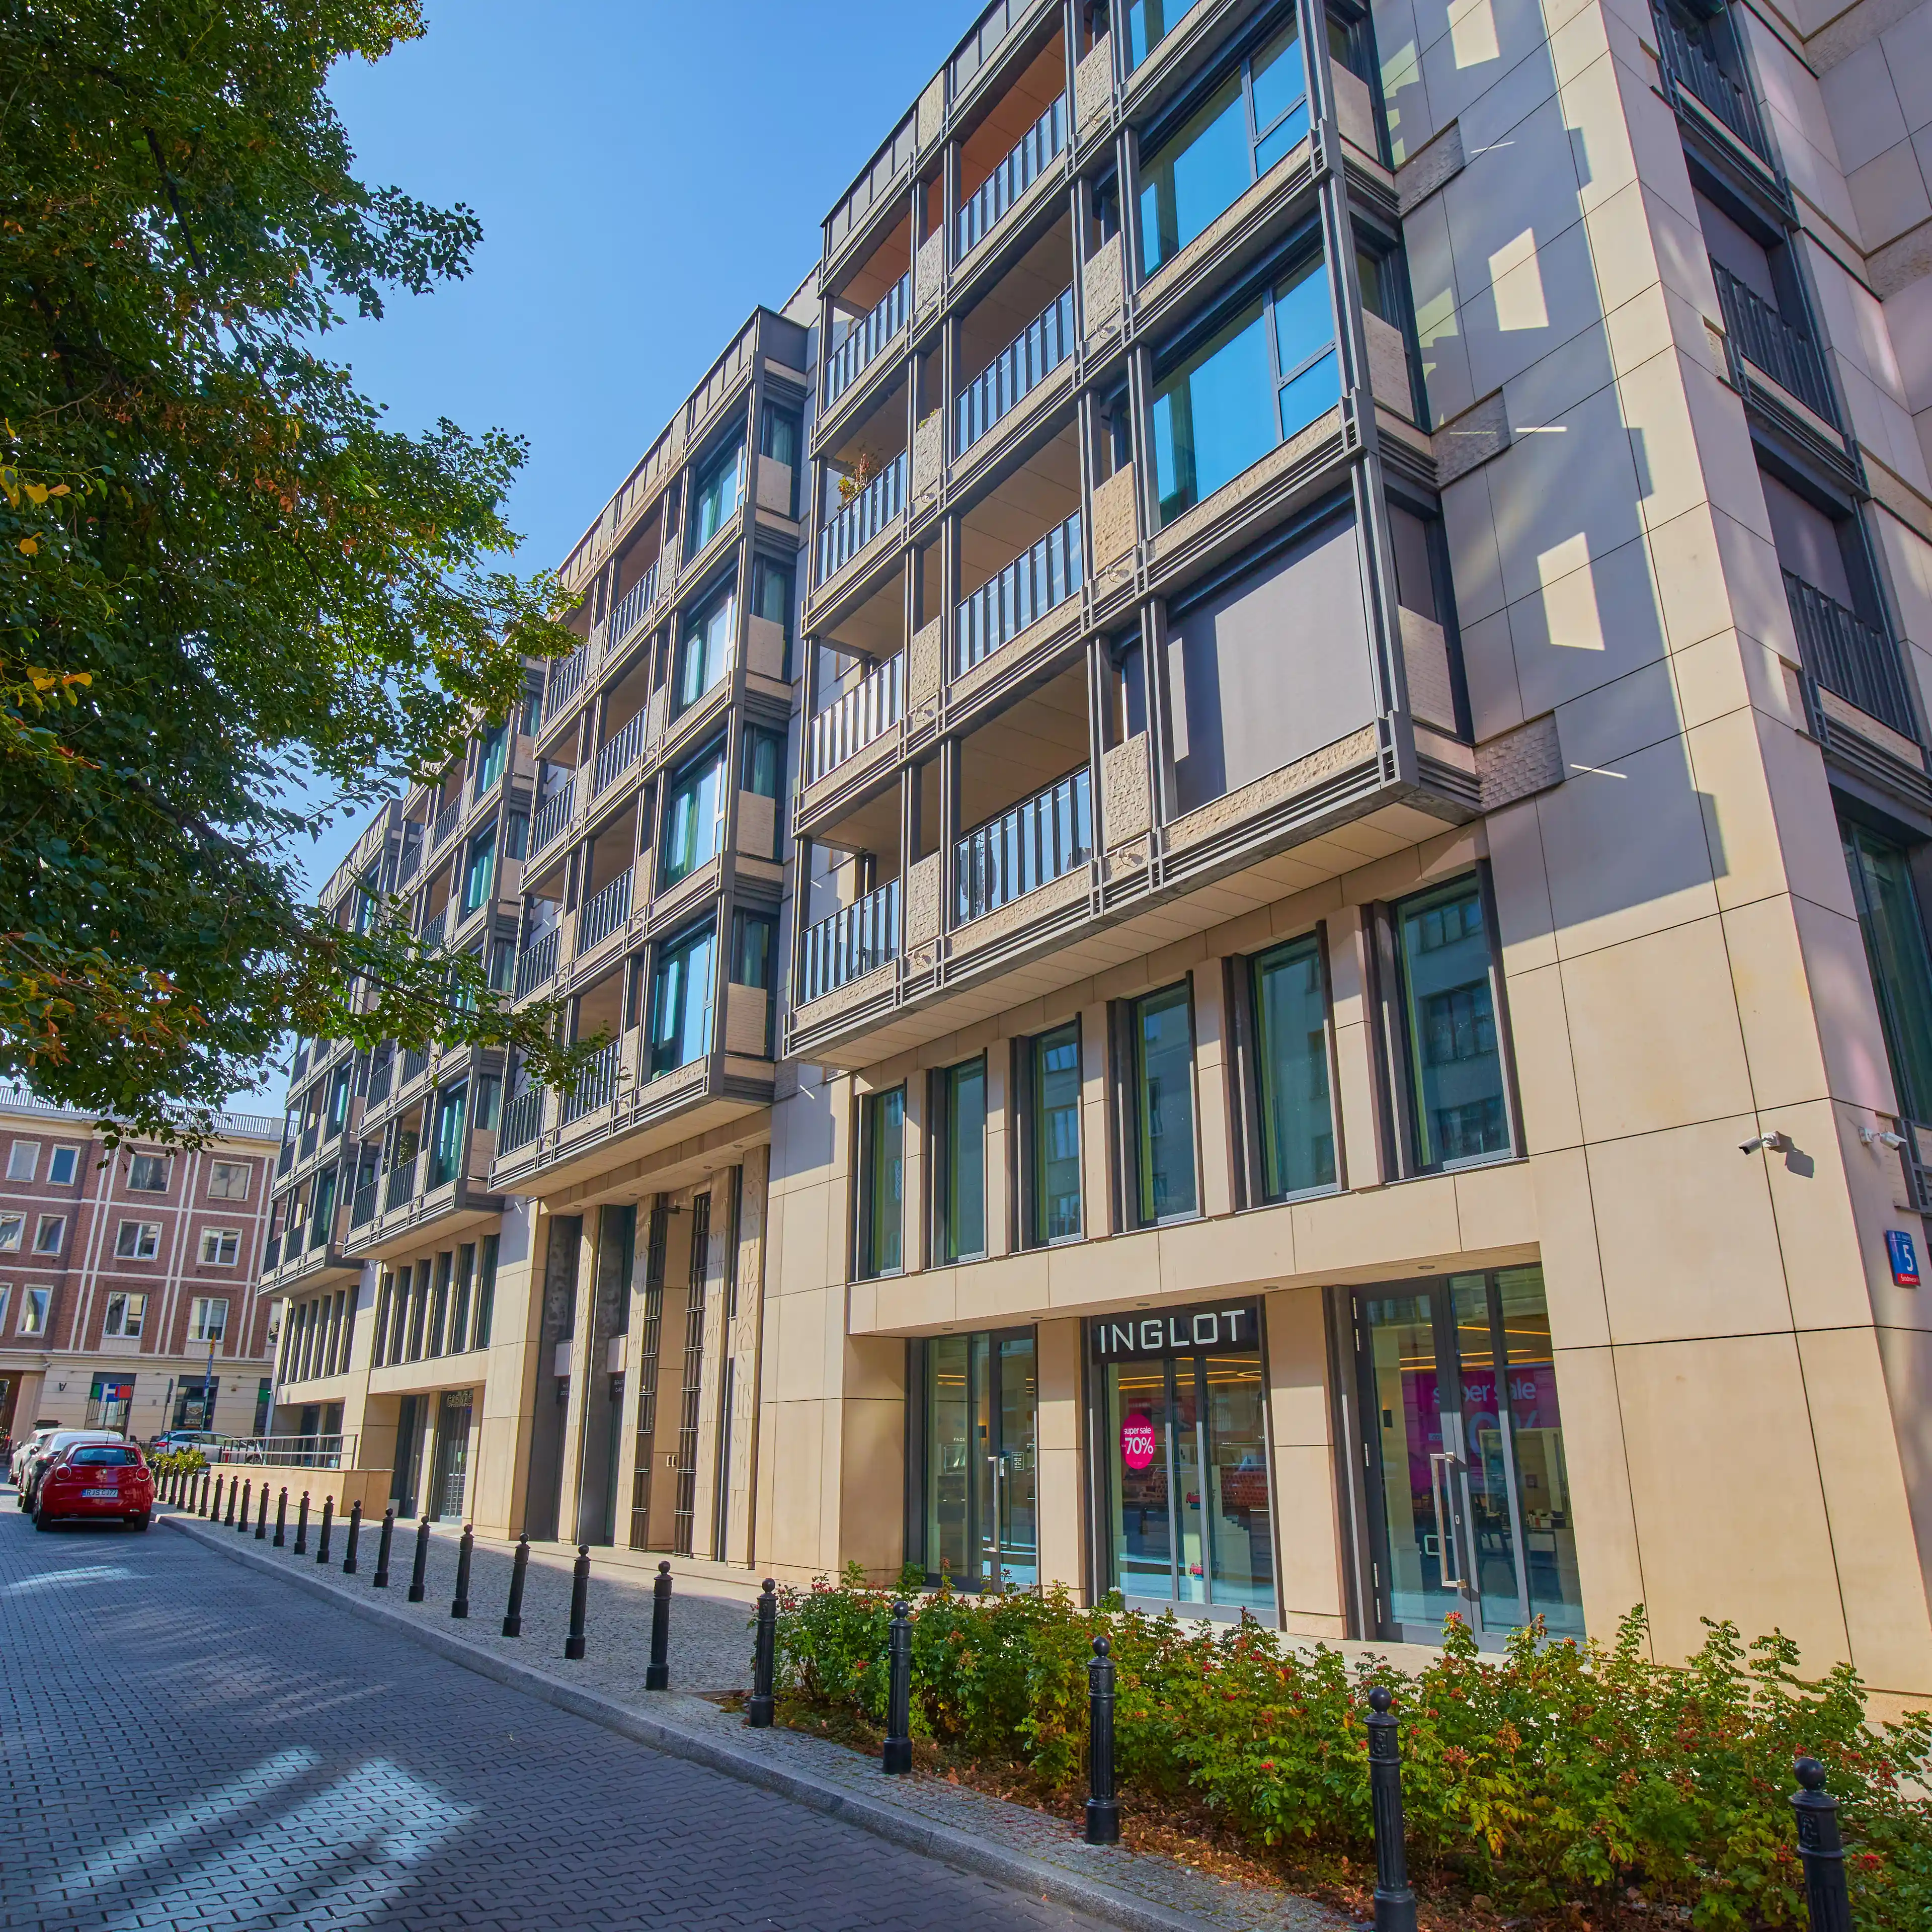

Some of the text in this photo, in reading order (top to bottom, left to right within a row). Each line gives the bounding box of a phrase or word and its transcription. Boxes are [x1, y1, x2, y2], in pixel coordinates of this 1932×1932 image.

[1903, 1244, 1913, 1271] 5
[1100, 1310, 1245, 1353] INGLOT
[1123, 1426, 1151, 1436] super sale
[1125, 1437, 1154, 1454] 70%
